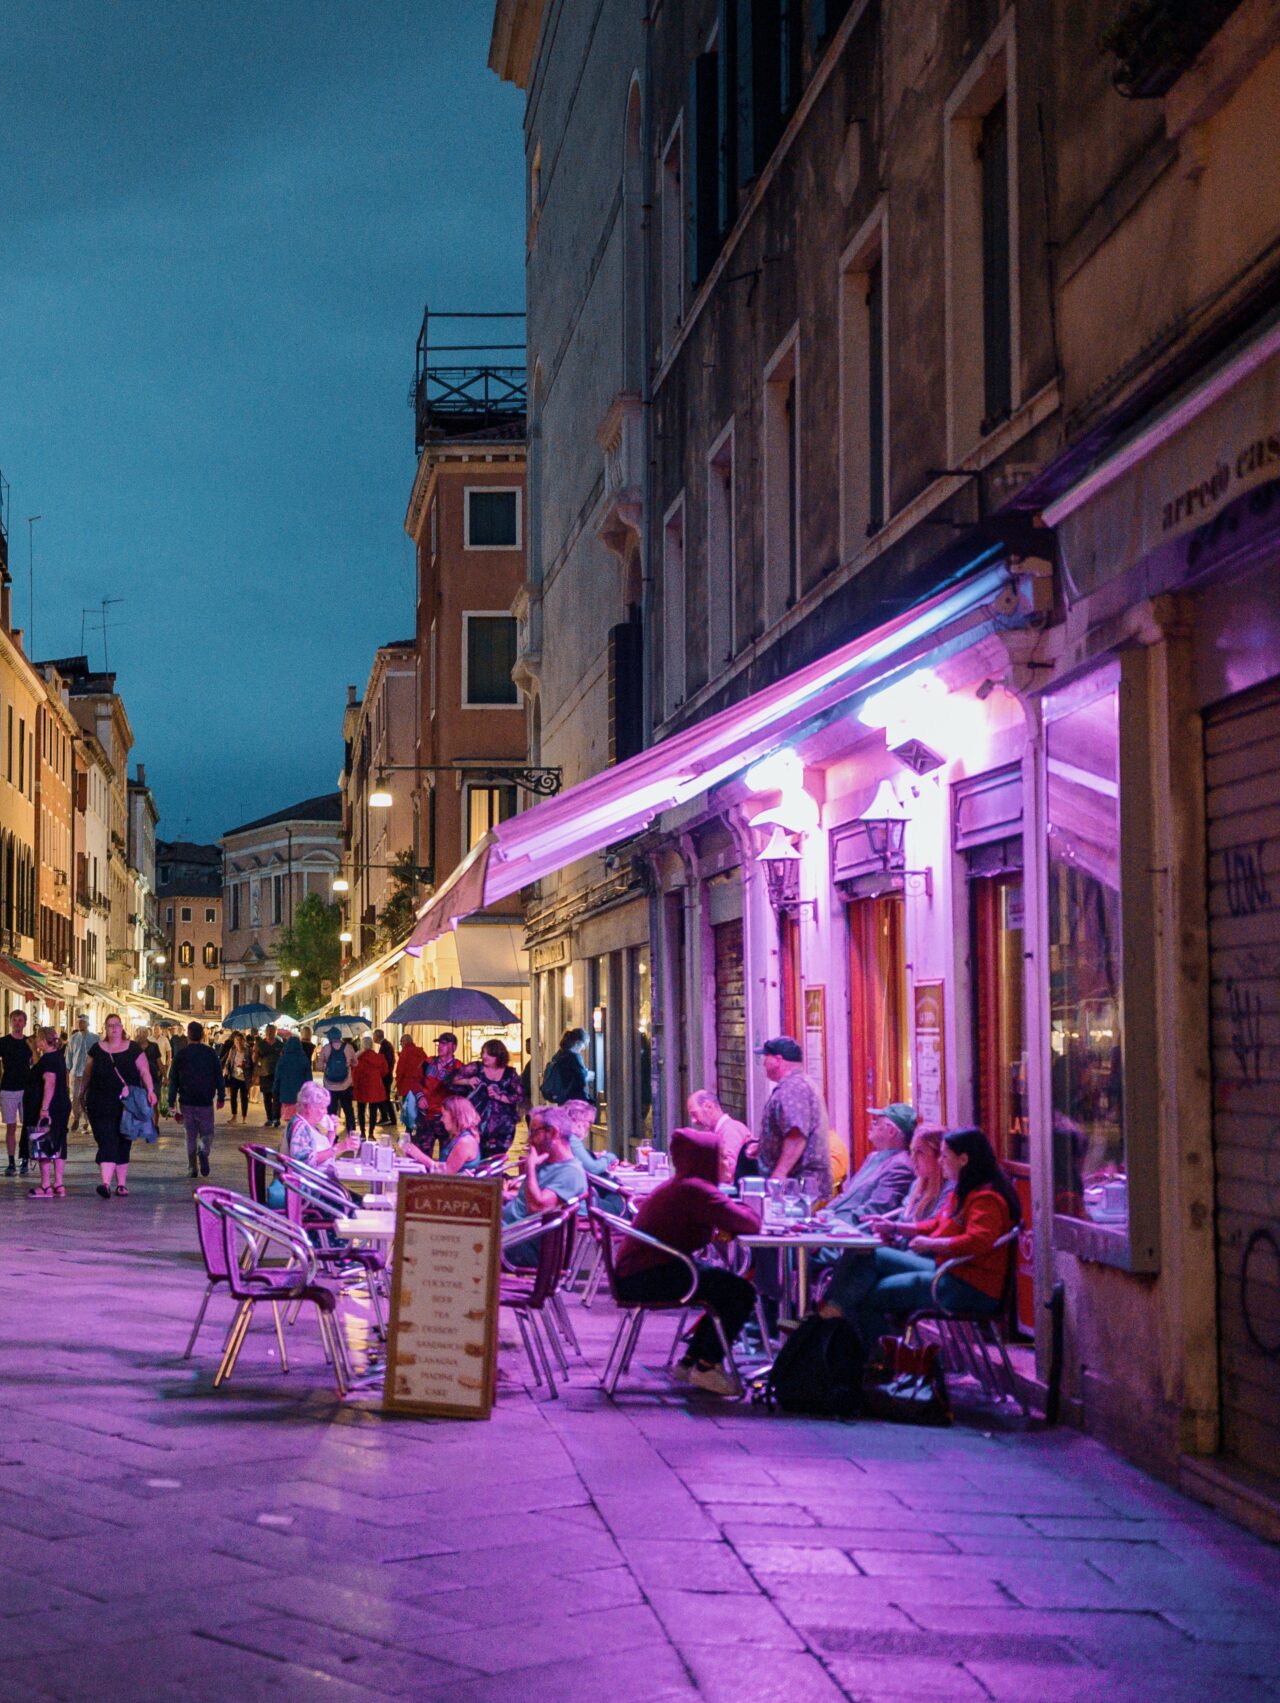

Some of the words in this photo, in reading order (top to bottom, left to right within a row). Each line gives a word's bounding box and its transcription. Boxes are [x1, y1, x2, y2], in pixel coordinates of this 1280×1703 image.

[414, 1197, 432, 1210] LA
[435, 1199, 481, 1215] TAPPA
[433, 1311, 450, 1319] TEA
